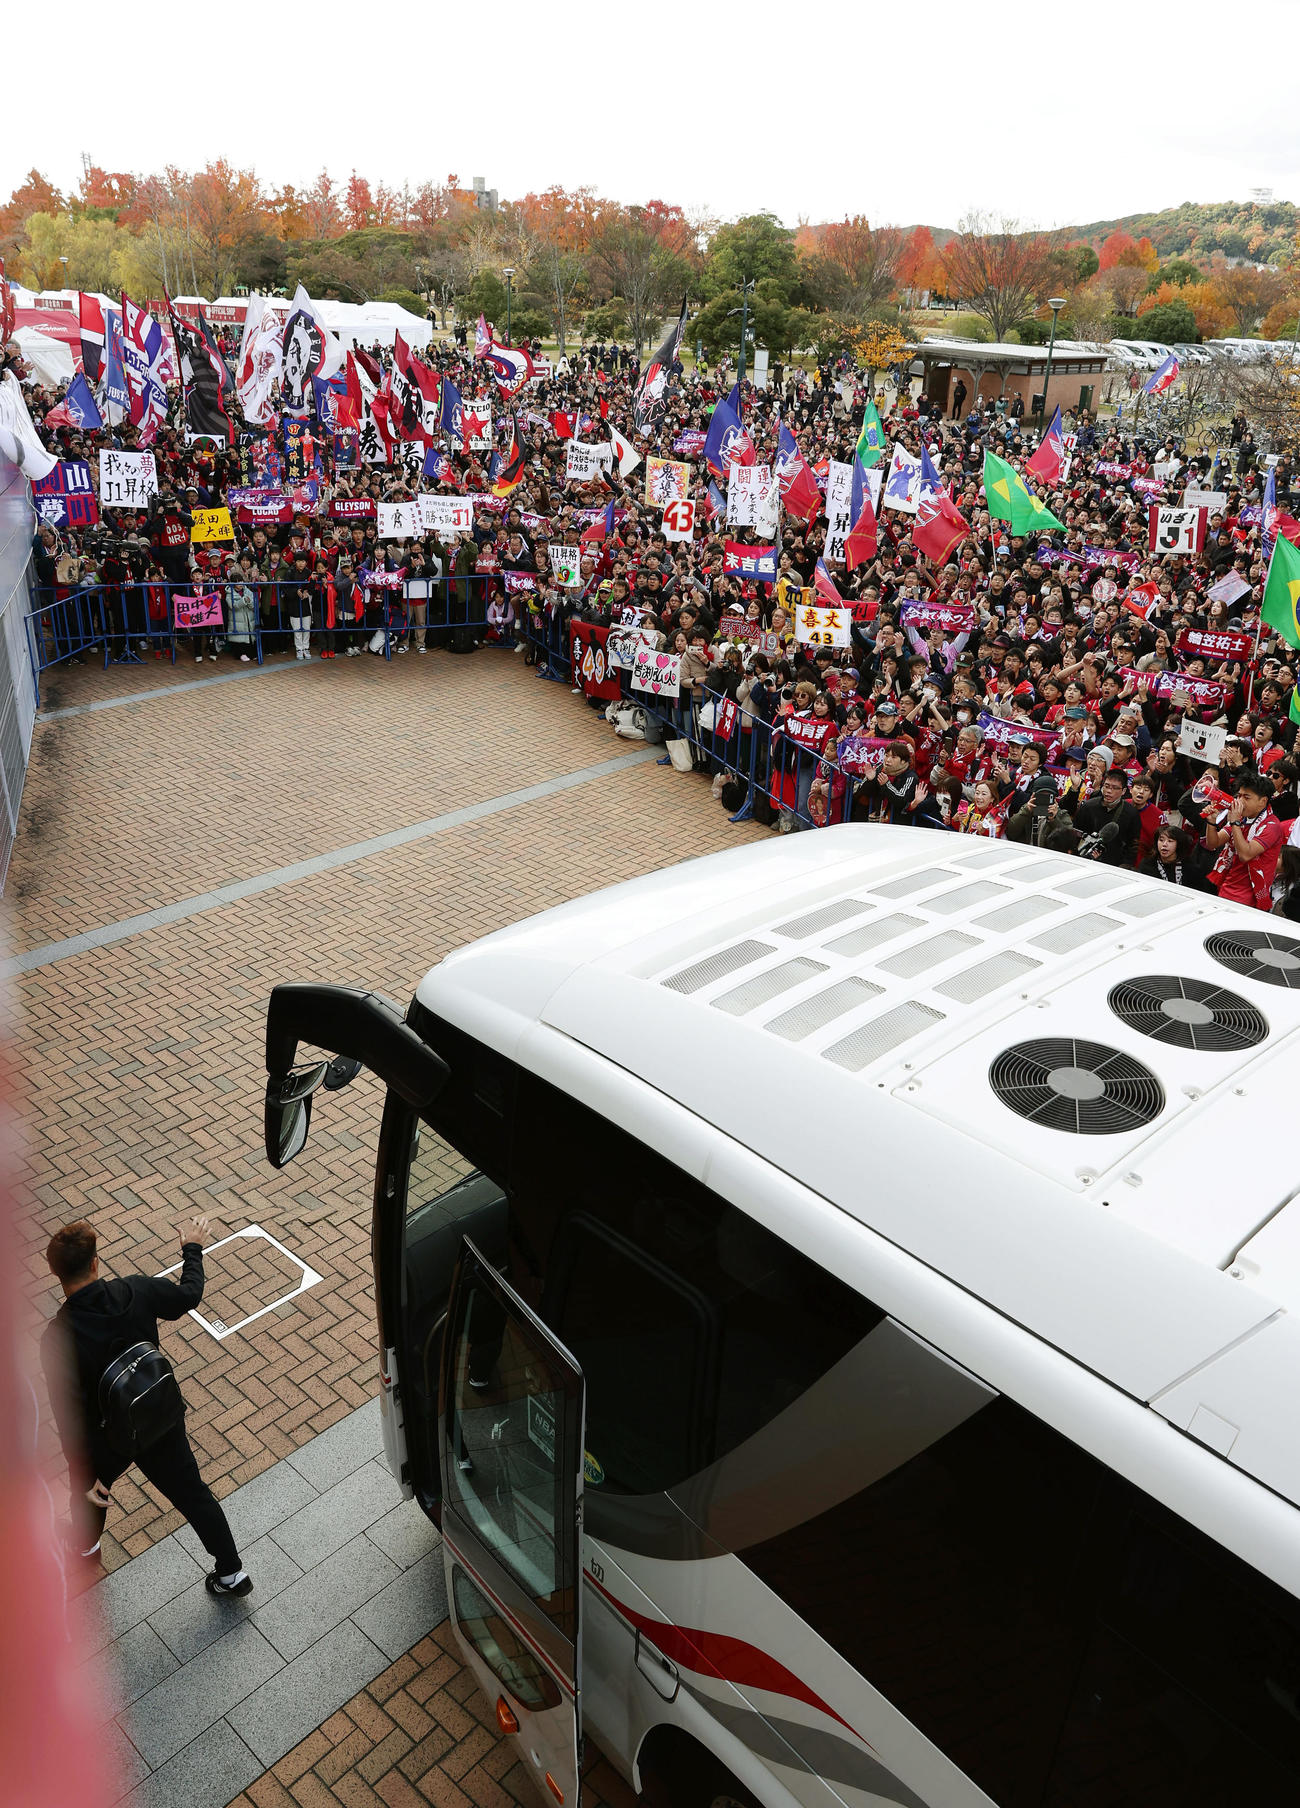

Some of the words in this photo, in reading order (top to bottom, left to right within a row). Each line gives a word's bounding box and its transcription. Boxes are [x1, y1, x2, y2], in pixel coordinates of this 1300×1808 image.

[104, 454, 153, 480] 我々の夢
[103, 478, 155, 504] J1昇格
[335, 502, 371, 512] GLEYSON
[664, 501, 694, 532] 43
[452, 509, 470, 526] J1
[725, 551, 773, 574] 末吉塁
[177, 599, 202, 613] 田中
[801, 609, 844, 629] 喜丈
[759, 632, 778, 650] 19
[808, 634, 835, 646] 43
